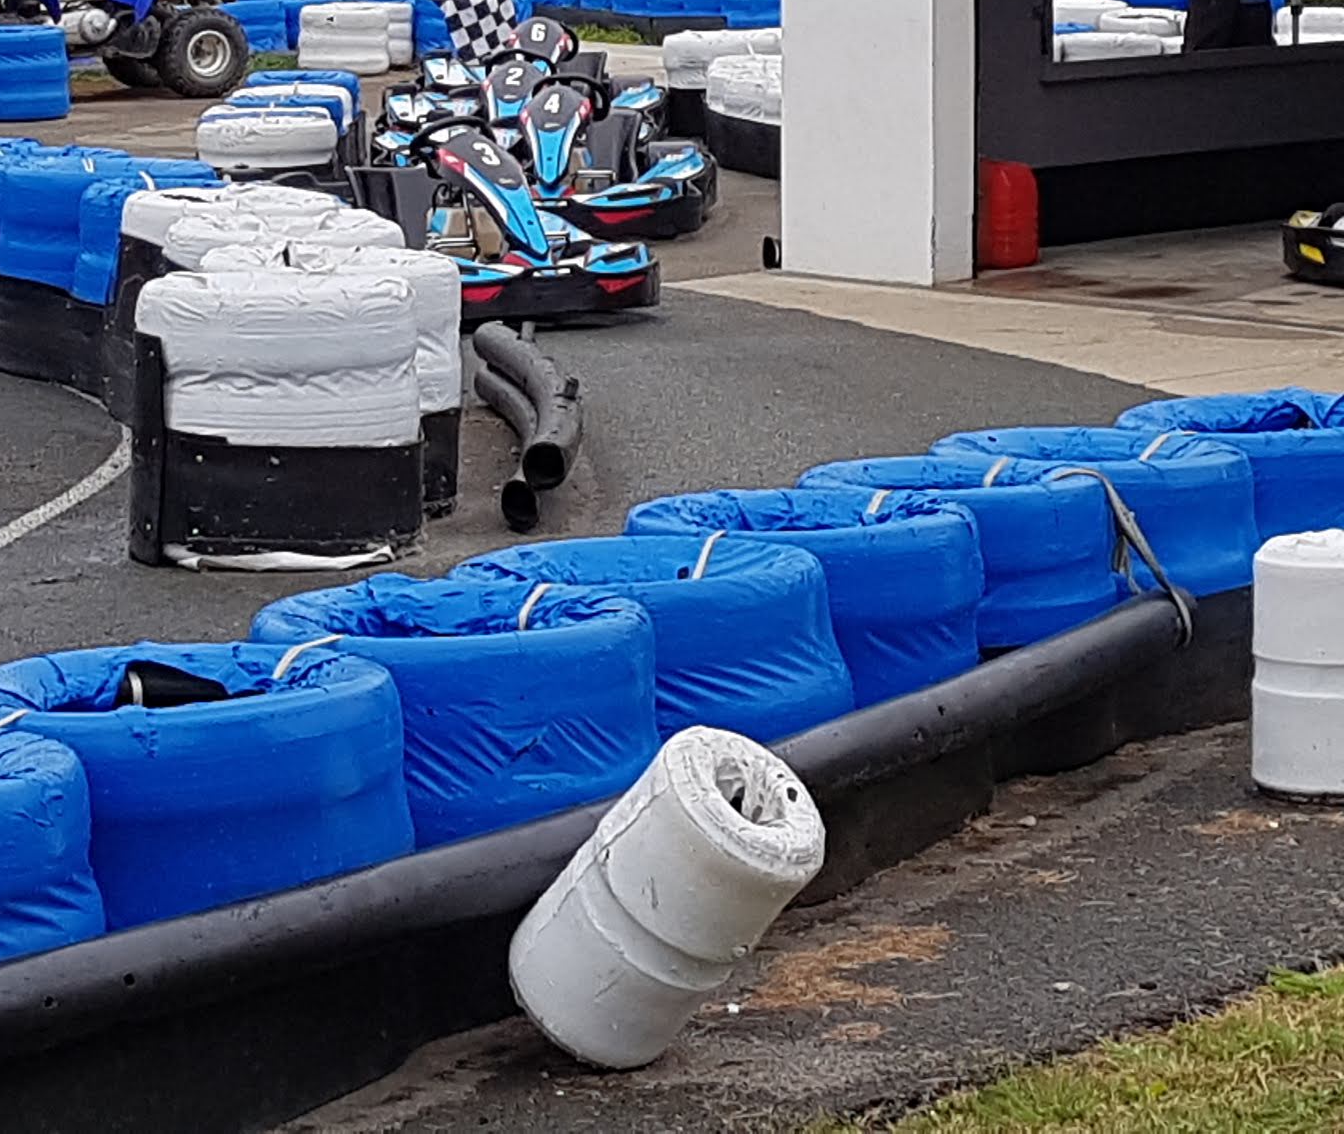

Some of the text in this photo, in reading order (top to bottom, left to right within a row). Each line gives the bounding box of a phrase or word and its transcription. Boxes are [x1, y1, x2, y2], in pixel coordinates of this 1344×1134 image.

[530, 22, 546, 42] 6
[505, 67, 524, 86] 2
[543, 93, 561, 114] 4
[472, 141, 502, 166] 3
